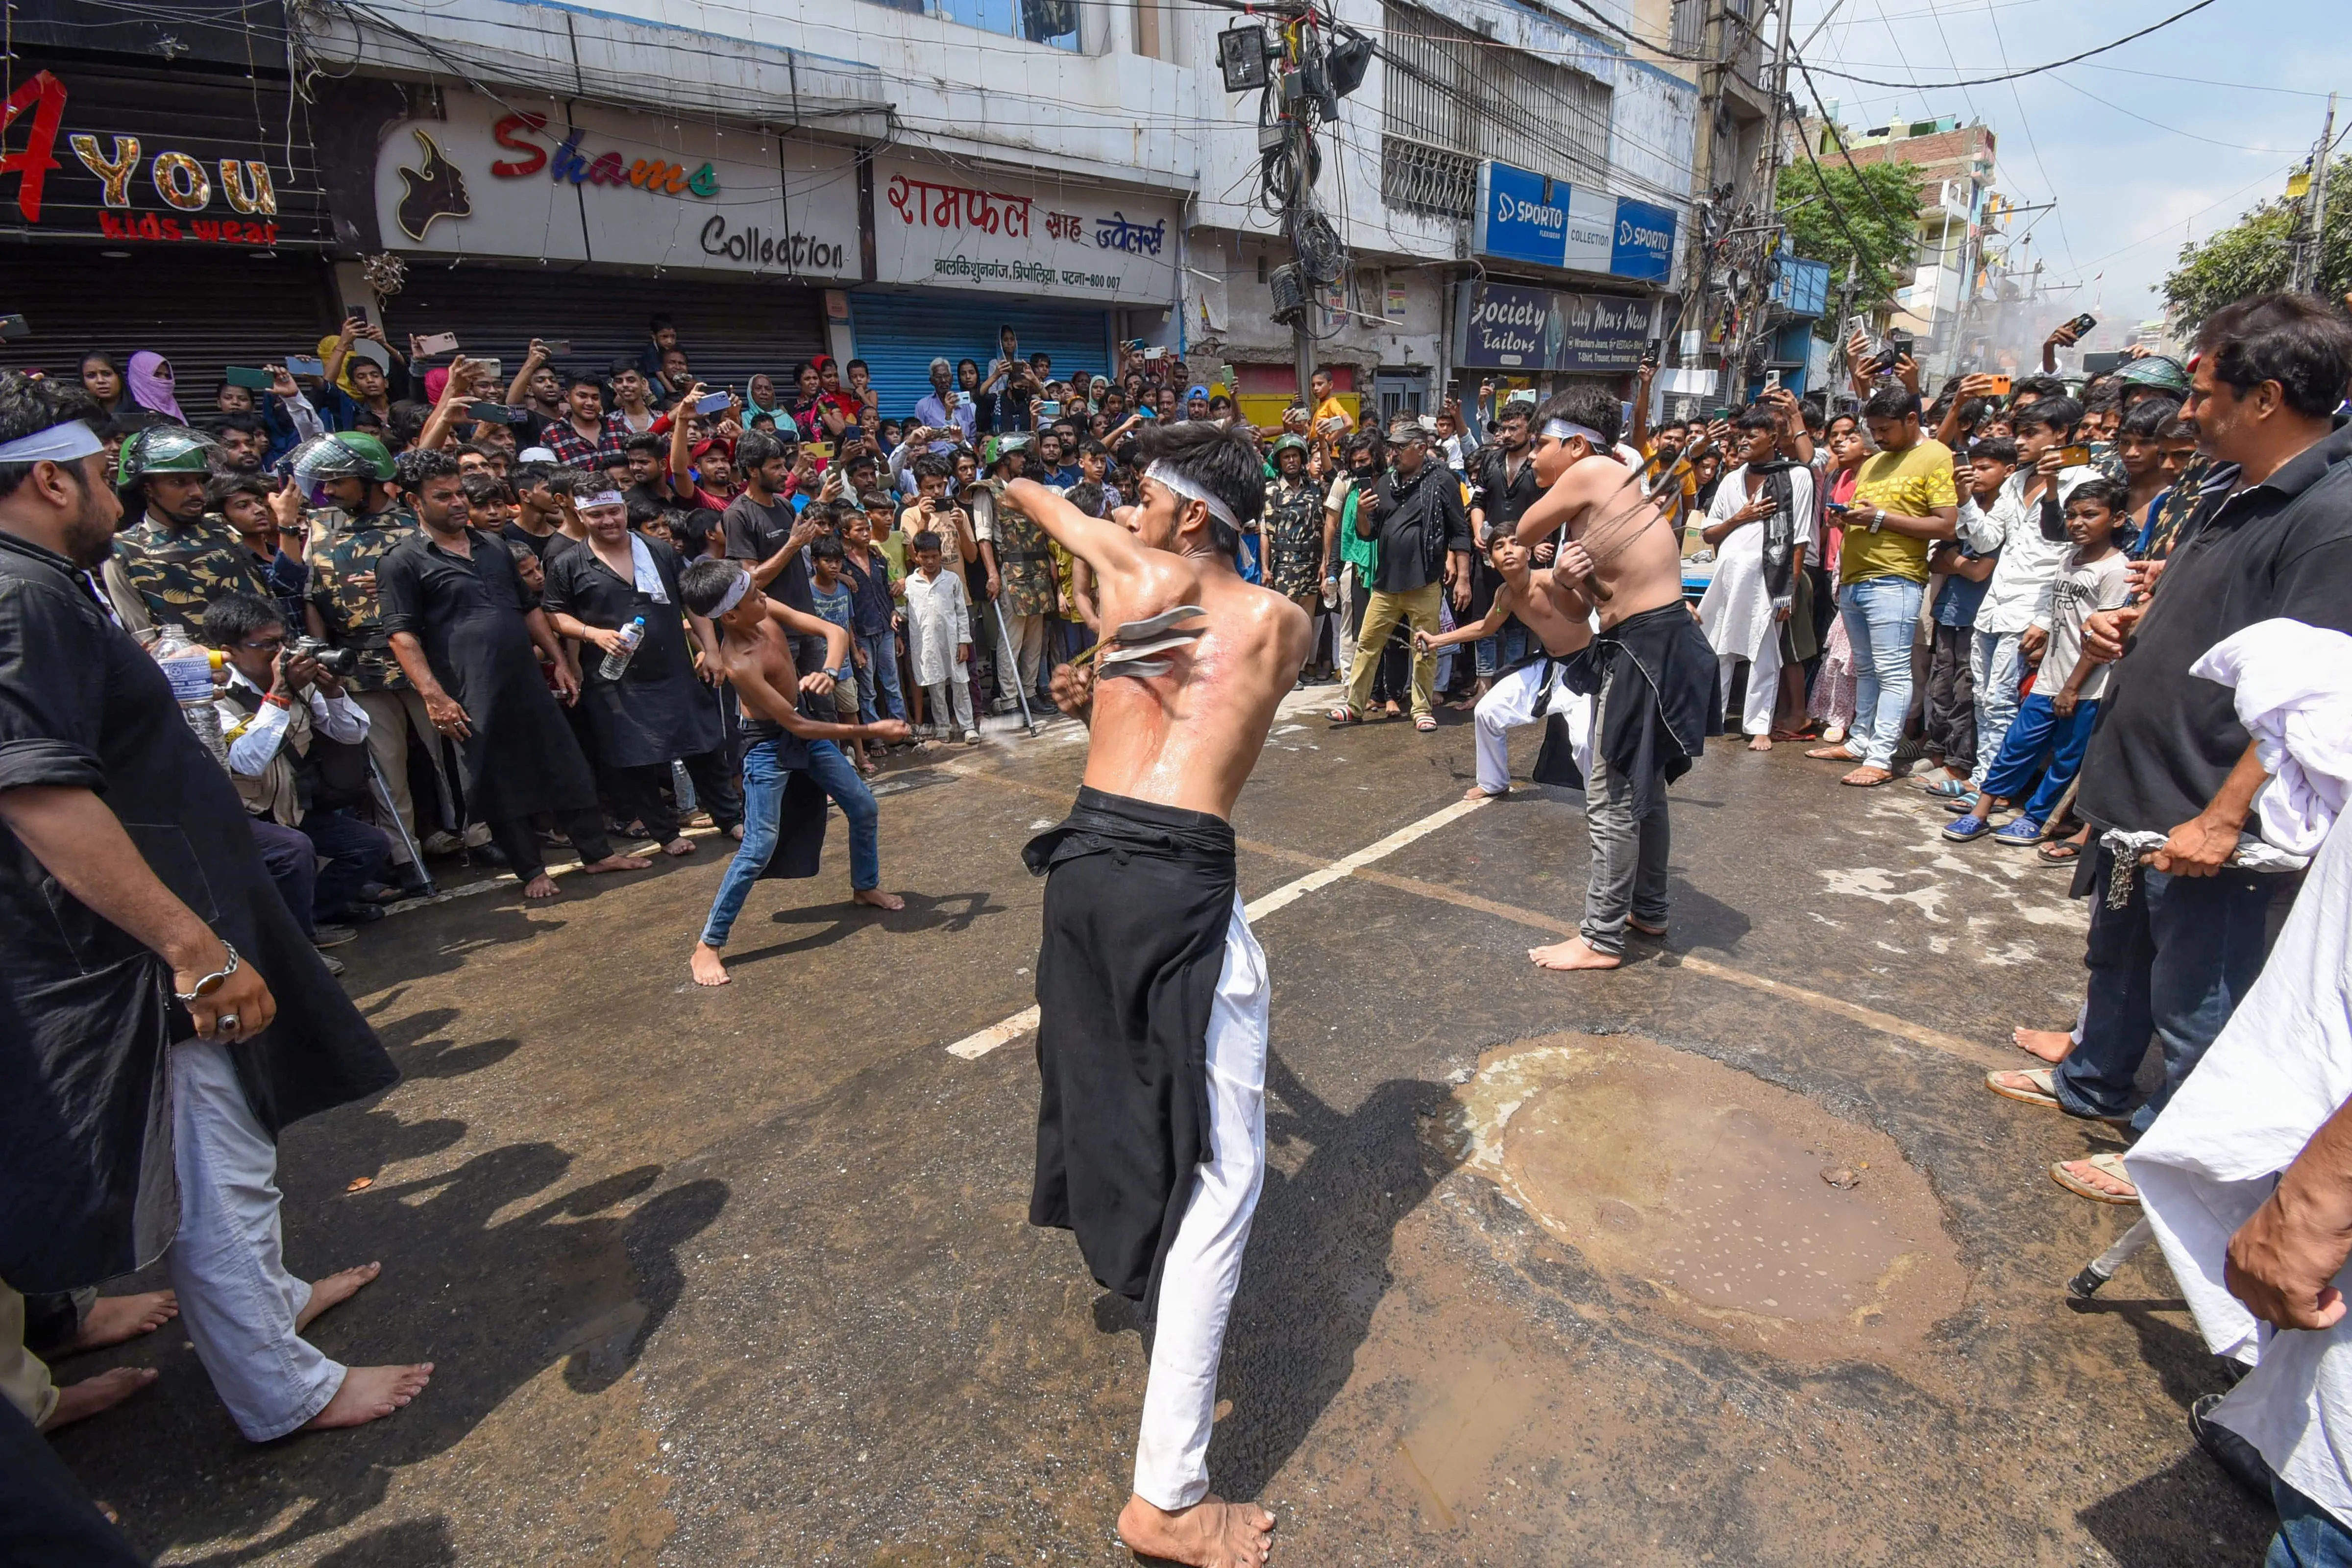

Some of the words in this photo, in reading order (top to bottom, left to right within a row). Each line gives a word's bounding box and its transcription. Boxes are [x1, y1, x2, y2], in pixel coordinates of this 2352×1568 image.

[491, 112, 720, 196] Shams
[98, 210, 183, 241] kids
[191, 220, 280, 245] wear
[888, 174, 1034, 238] रामफल
[1045, 211, 1082, 243] साह
[1096, 211, 1166, 256] ज्वेलर्स
[1517, 200, 1562, 229] SPORTO
[700, 215, 843, 269] Collection
[1571, 228, 1609, 247] COLLECTION
[1633, 226, 1668, 251] SPORTO
[1106, 274, 1121, 290] 007
[1471, 287, 1546, 335] Society
[1571, 299, 1591, 335] City
[1593, 300, 1623, 333] Men's
[1624, 302, 1647, 333] Wear
[1482, 328, 1536, 353] Tailors
